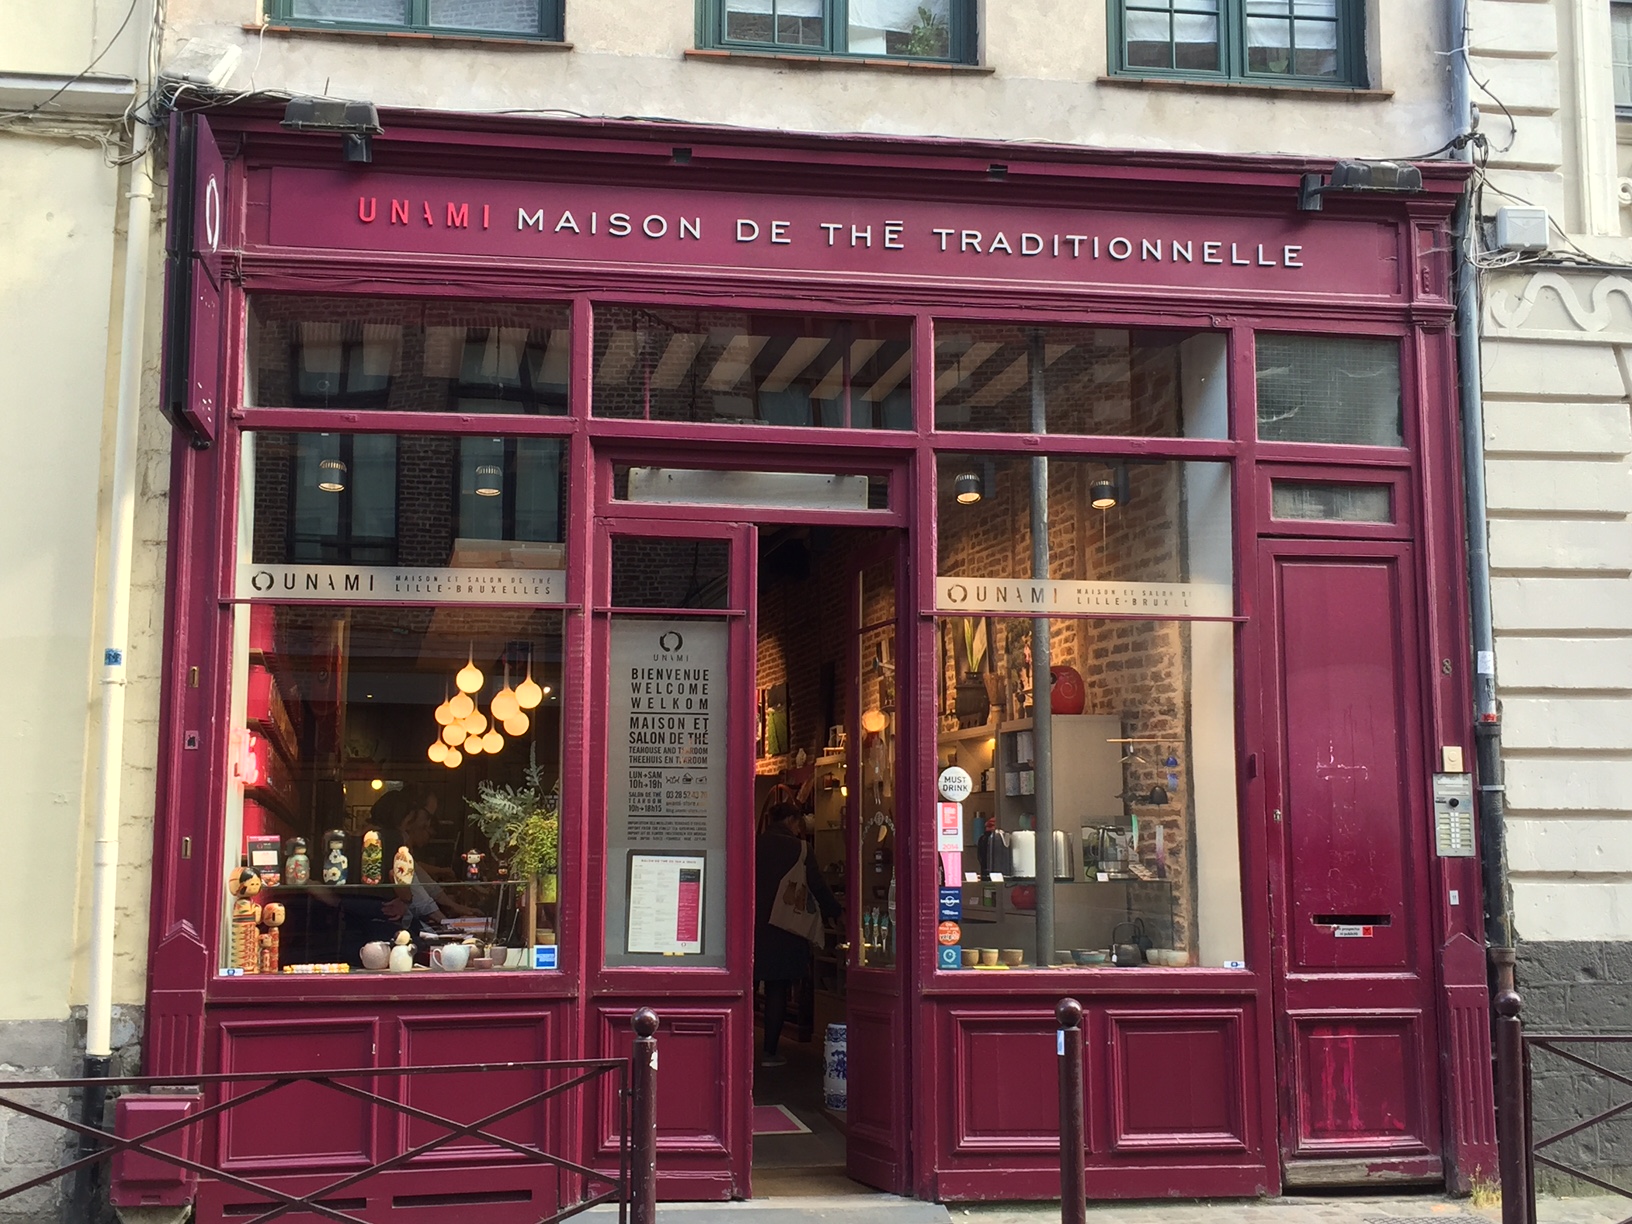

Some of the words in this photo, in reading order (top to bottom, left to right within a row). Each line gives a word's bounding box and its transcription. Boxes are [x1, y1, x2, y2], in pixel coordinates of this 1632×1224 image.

[517, 207, 701, 240] MAISON
[736, 218, 791, 244] DE
[932, 228, 1304, 268] TRADITIONNELLE
[395, 575, 438, 583] MAISON
[467, 576, 502, 584] SALON
[1442, 658, 1452, 675] 8
[631, 668, 709, 681] BIENVENUE
[631, 682, 709, 695] WELCOME
[631, 697, 708, 710] WELKOM
[630, 717, 685, 730] MAISON
[693, 717, 709, 730] ET
[629, 731, 666, 745] SALON
[669, 732, 684, 745] DE
[688, 730, 709, 745] THÉ
[629, 746, 662, 754] TEAHOUSE
[629, 755, 662, 764] THEEHUIS
[664, 756, 673, 764] EN
[629, 771, 643, 779] LUN
[648, 771, 662, 779] SAM
[944, 776, 967, 784] MUST
[629, 779, 643, 789] 10h
[649, 779, 662, 789] 19h
[943, 784, 968, 792] DRINK
[666, 791, 673, 799] 03
[675, 791, 682, 799] 28
